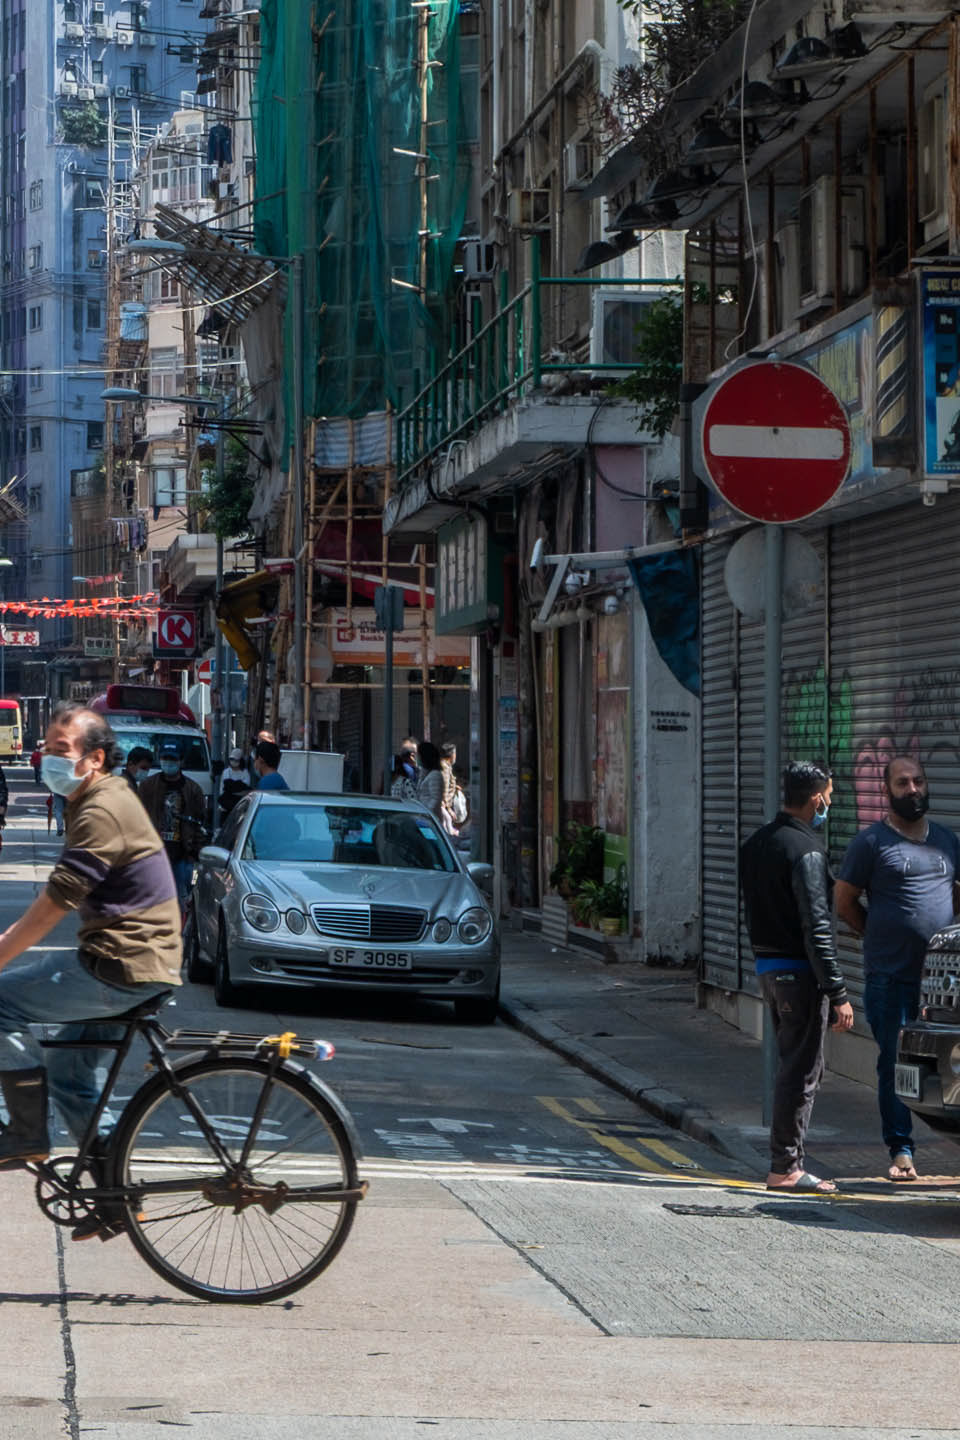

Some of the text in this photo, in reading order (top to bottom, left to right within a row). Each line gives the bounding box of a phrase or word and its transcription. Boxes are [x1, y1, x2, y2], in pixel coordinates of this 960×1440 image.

[164, 615, 191, 645] K
[333, 949, 409, 968] SF 3095
